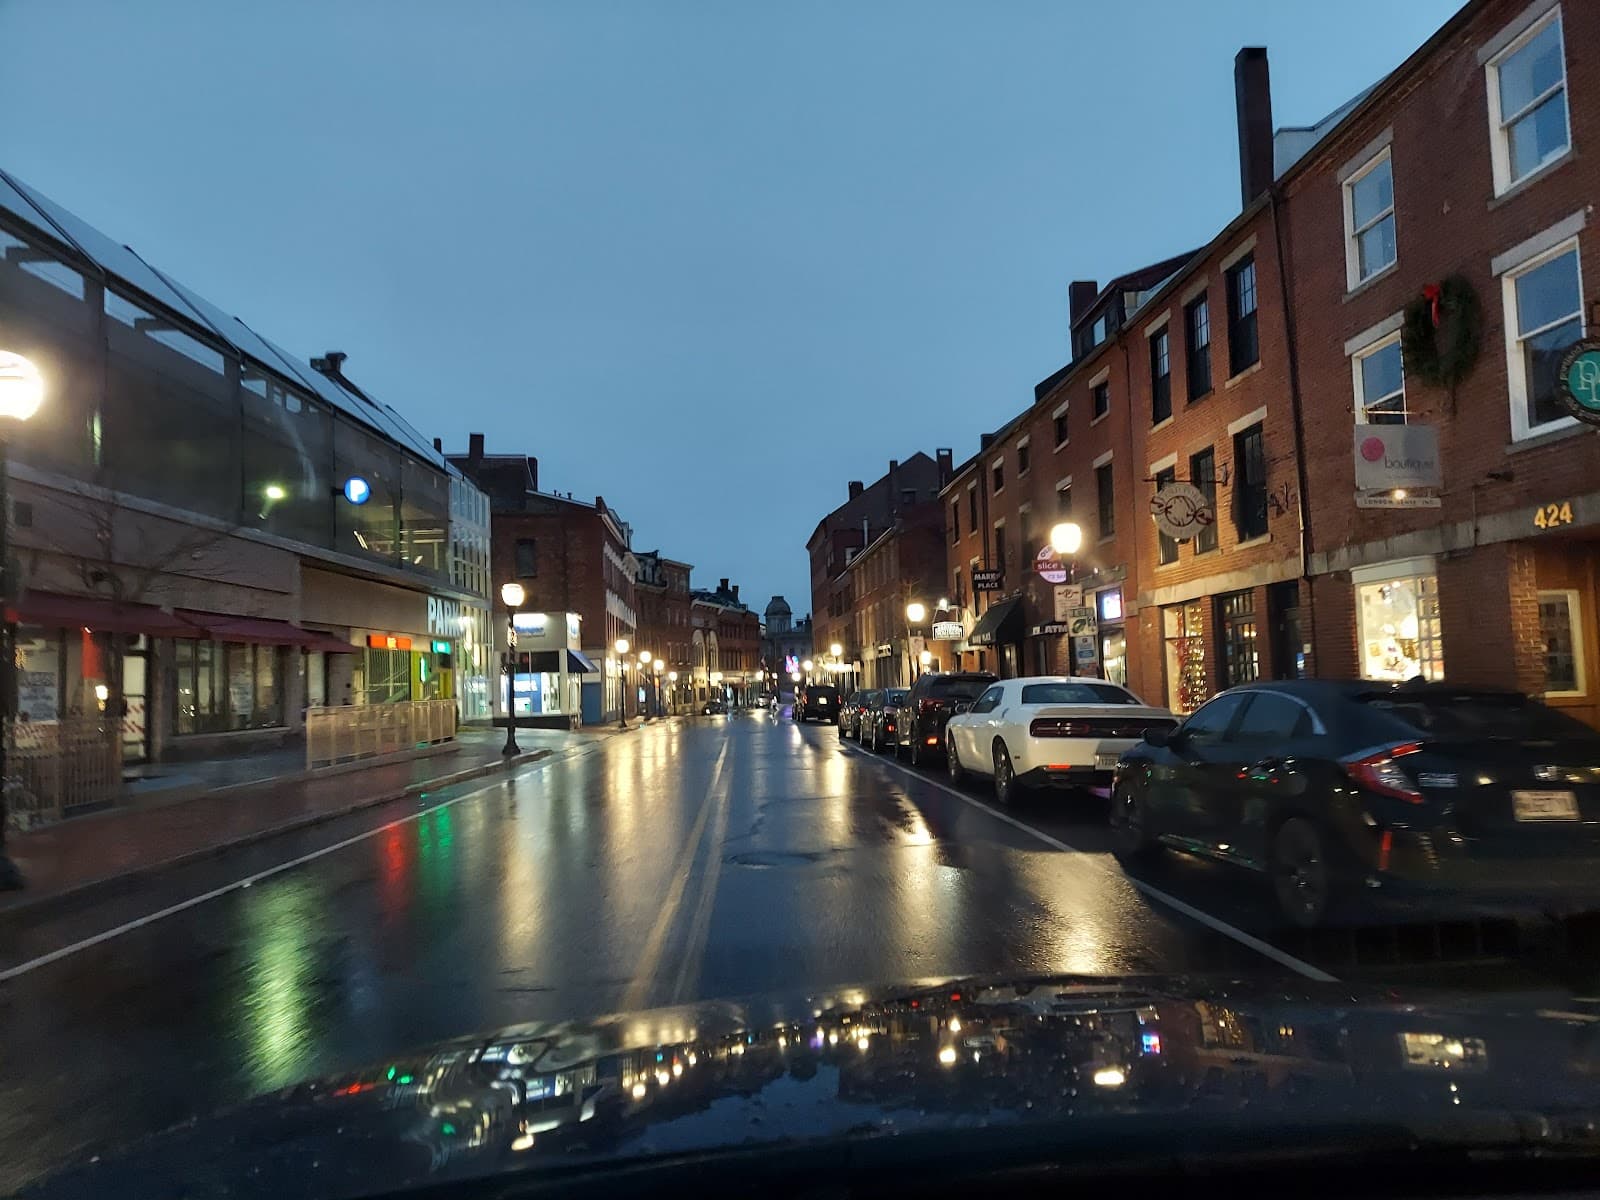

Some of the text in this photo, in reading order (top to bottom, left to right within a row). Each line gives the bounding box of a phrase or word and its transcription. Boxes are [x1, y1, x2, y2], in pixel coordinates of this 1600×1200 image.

[350, 480, 366, 501] P
[1534, 501, 1573, 529] 424
[1037, 561, 1058, 570] slice
[1044, 624, 1068, 634] ATM
